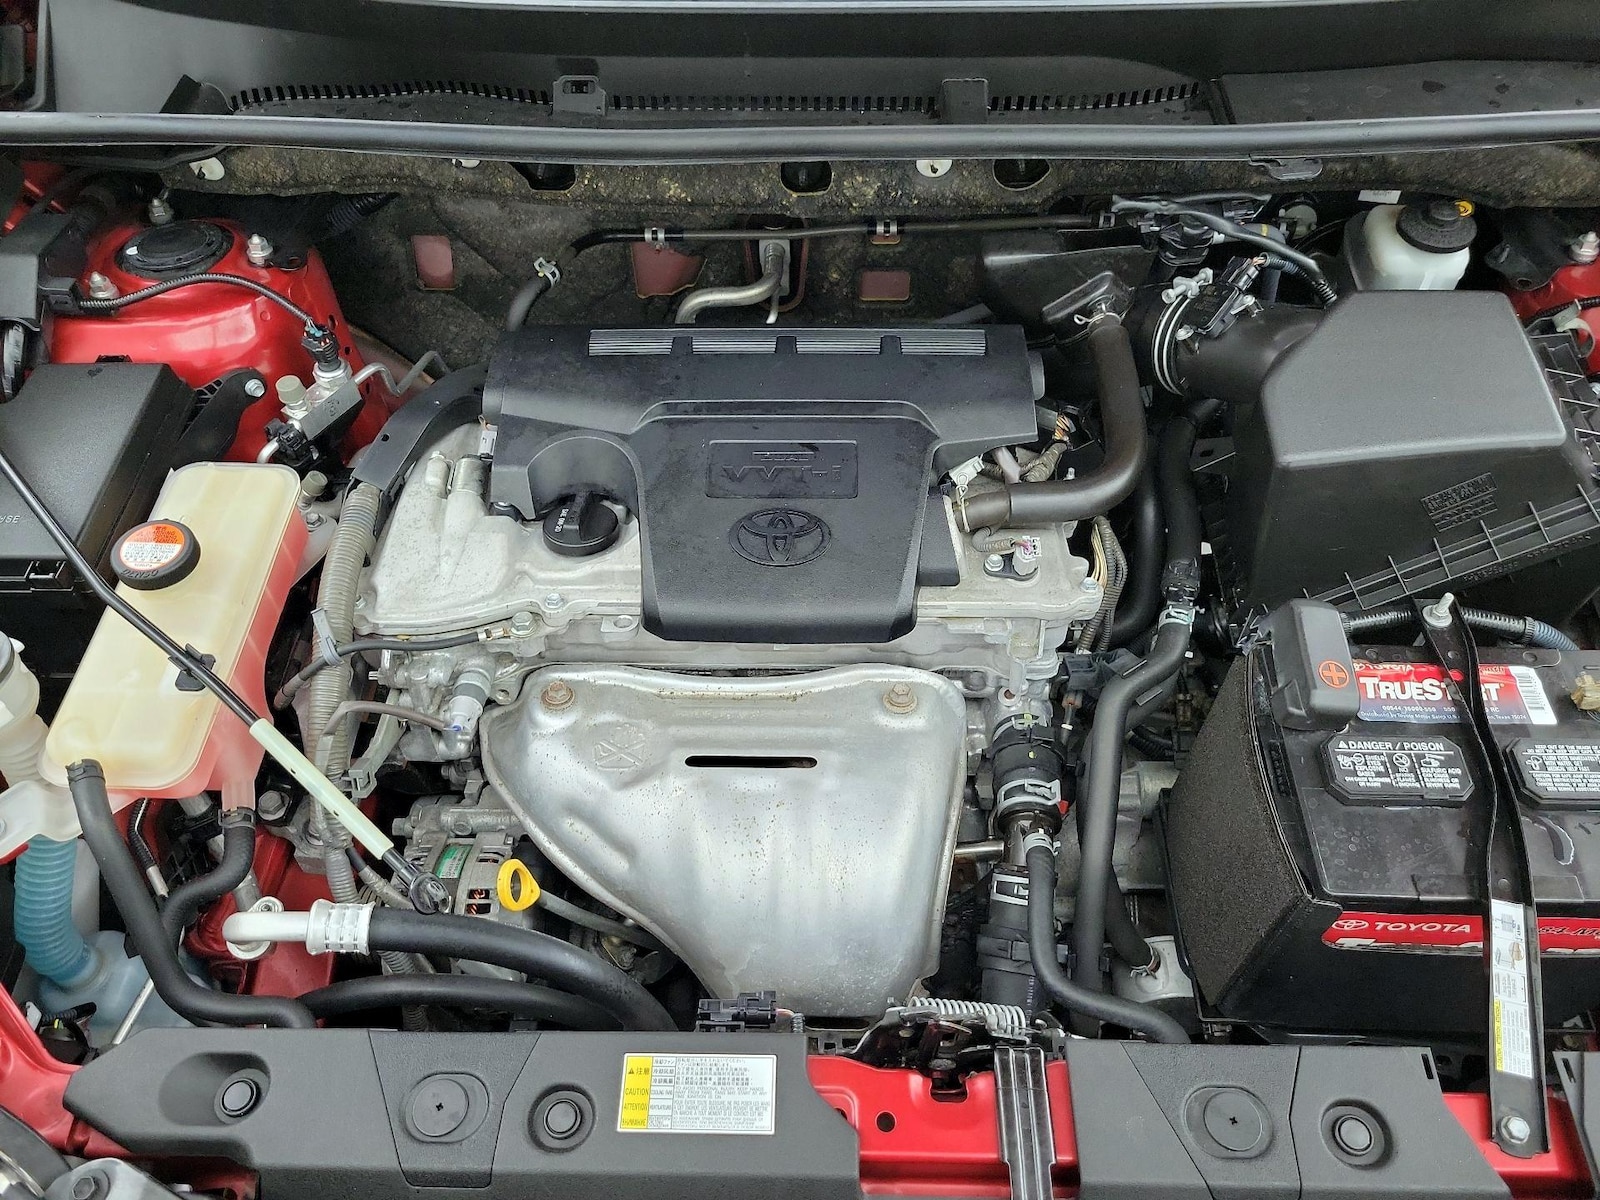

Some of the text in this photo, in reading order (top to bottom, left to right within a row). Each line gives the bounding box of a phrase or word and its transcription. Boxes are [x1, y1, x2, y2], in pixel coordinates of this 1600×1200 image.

[120, 569, 159, 579] DENSO
[1348, 741, 1394, 750] DANGER
[1403, 742, 1445, 751] POISON
[1374, 922, 1471, 933] TOYOTA
[624, 1087, 649, 1095] CAUTION
[623, 1102, 648, 1110] ATTENTION
